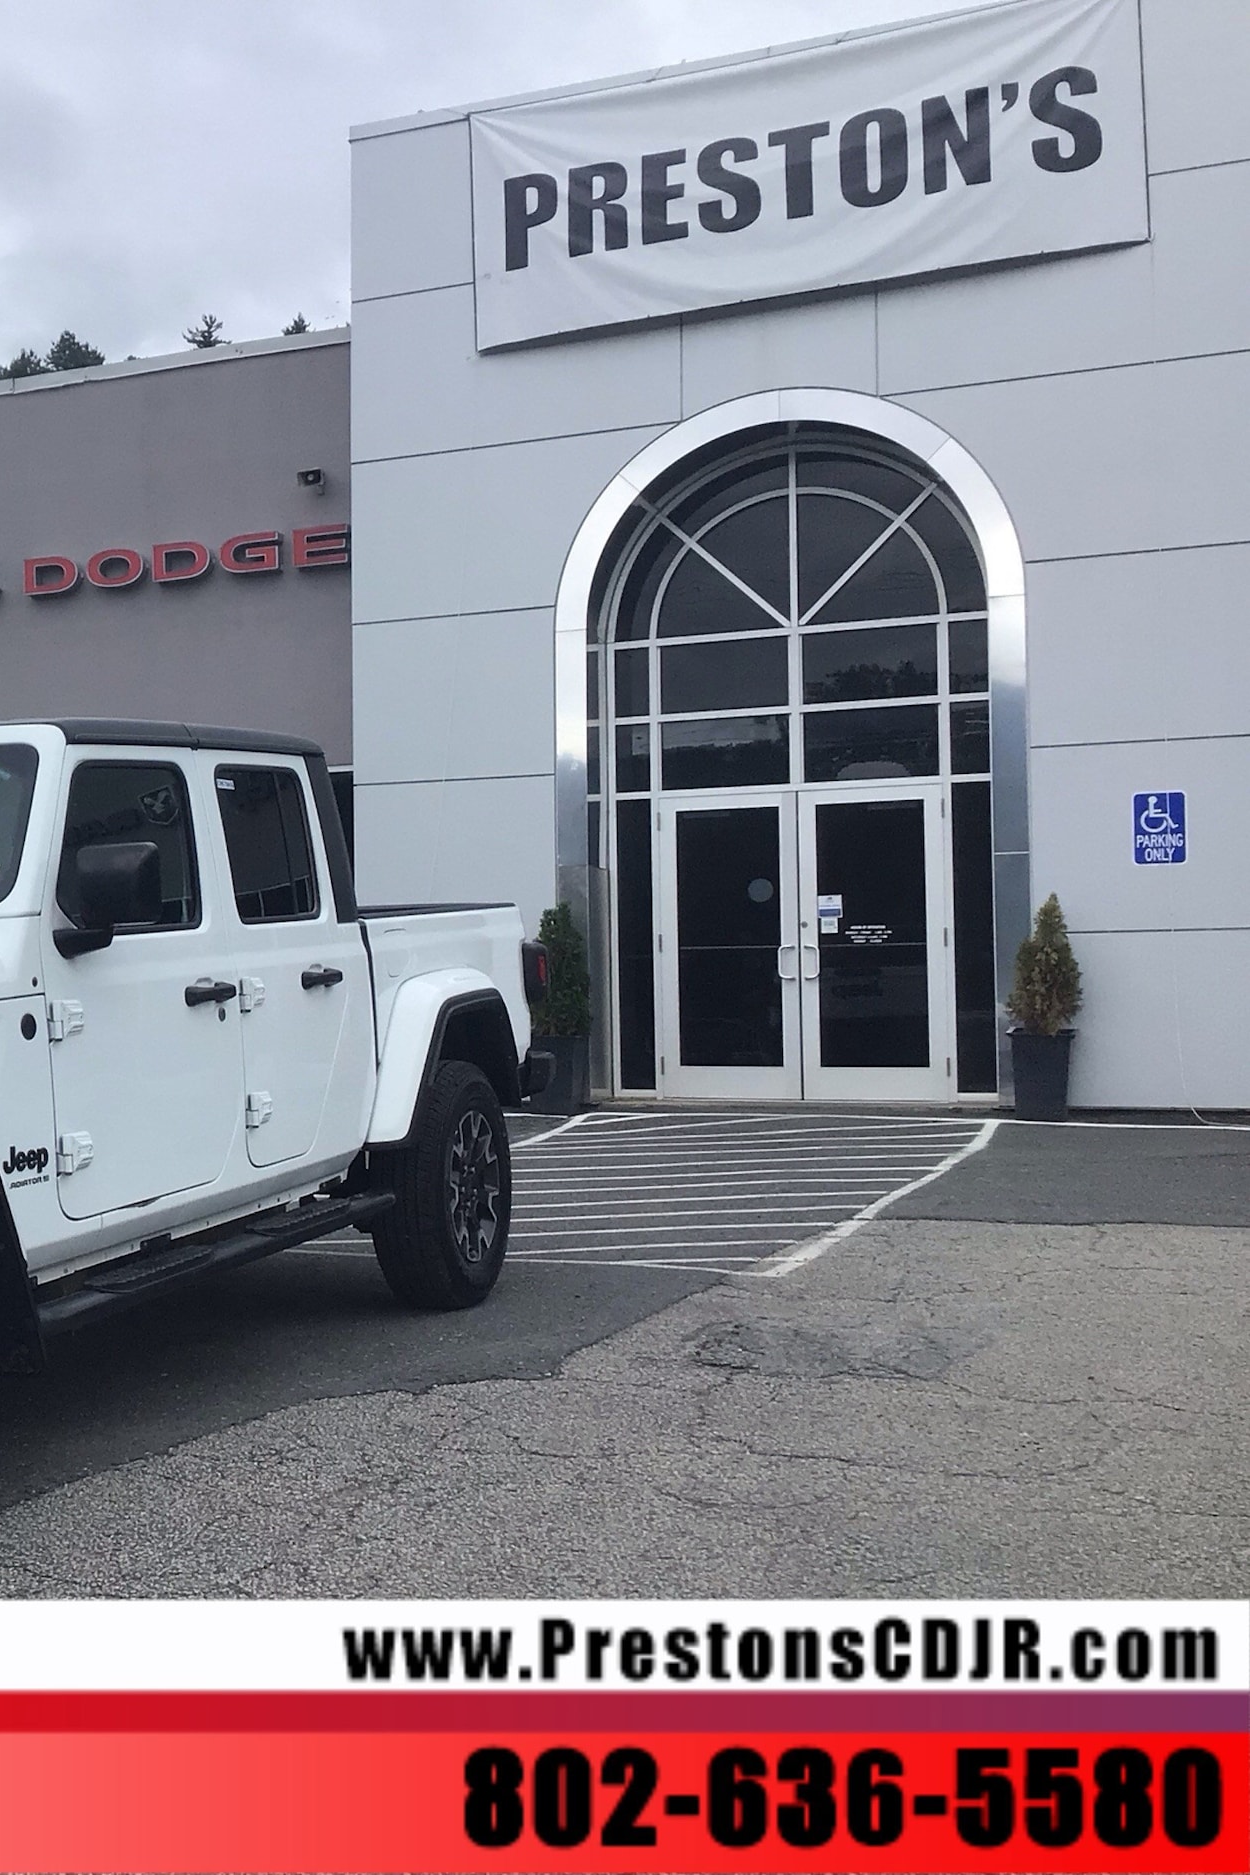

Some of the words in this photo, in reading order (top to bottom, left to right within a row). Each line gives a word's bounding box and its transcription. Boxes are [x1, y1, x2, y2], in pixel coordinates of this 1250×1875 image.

[502, 66, 1103, 272] PRESTON'S
[23, 523, 350, 597] DODGE
[1136, 833, 1184, 848] PARKING
[1144, 847, 1175, 862] ONLY
[2, 1146, 49, 1174] Jeep
